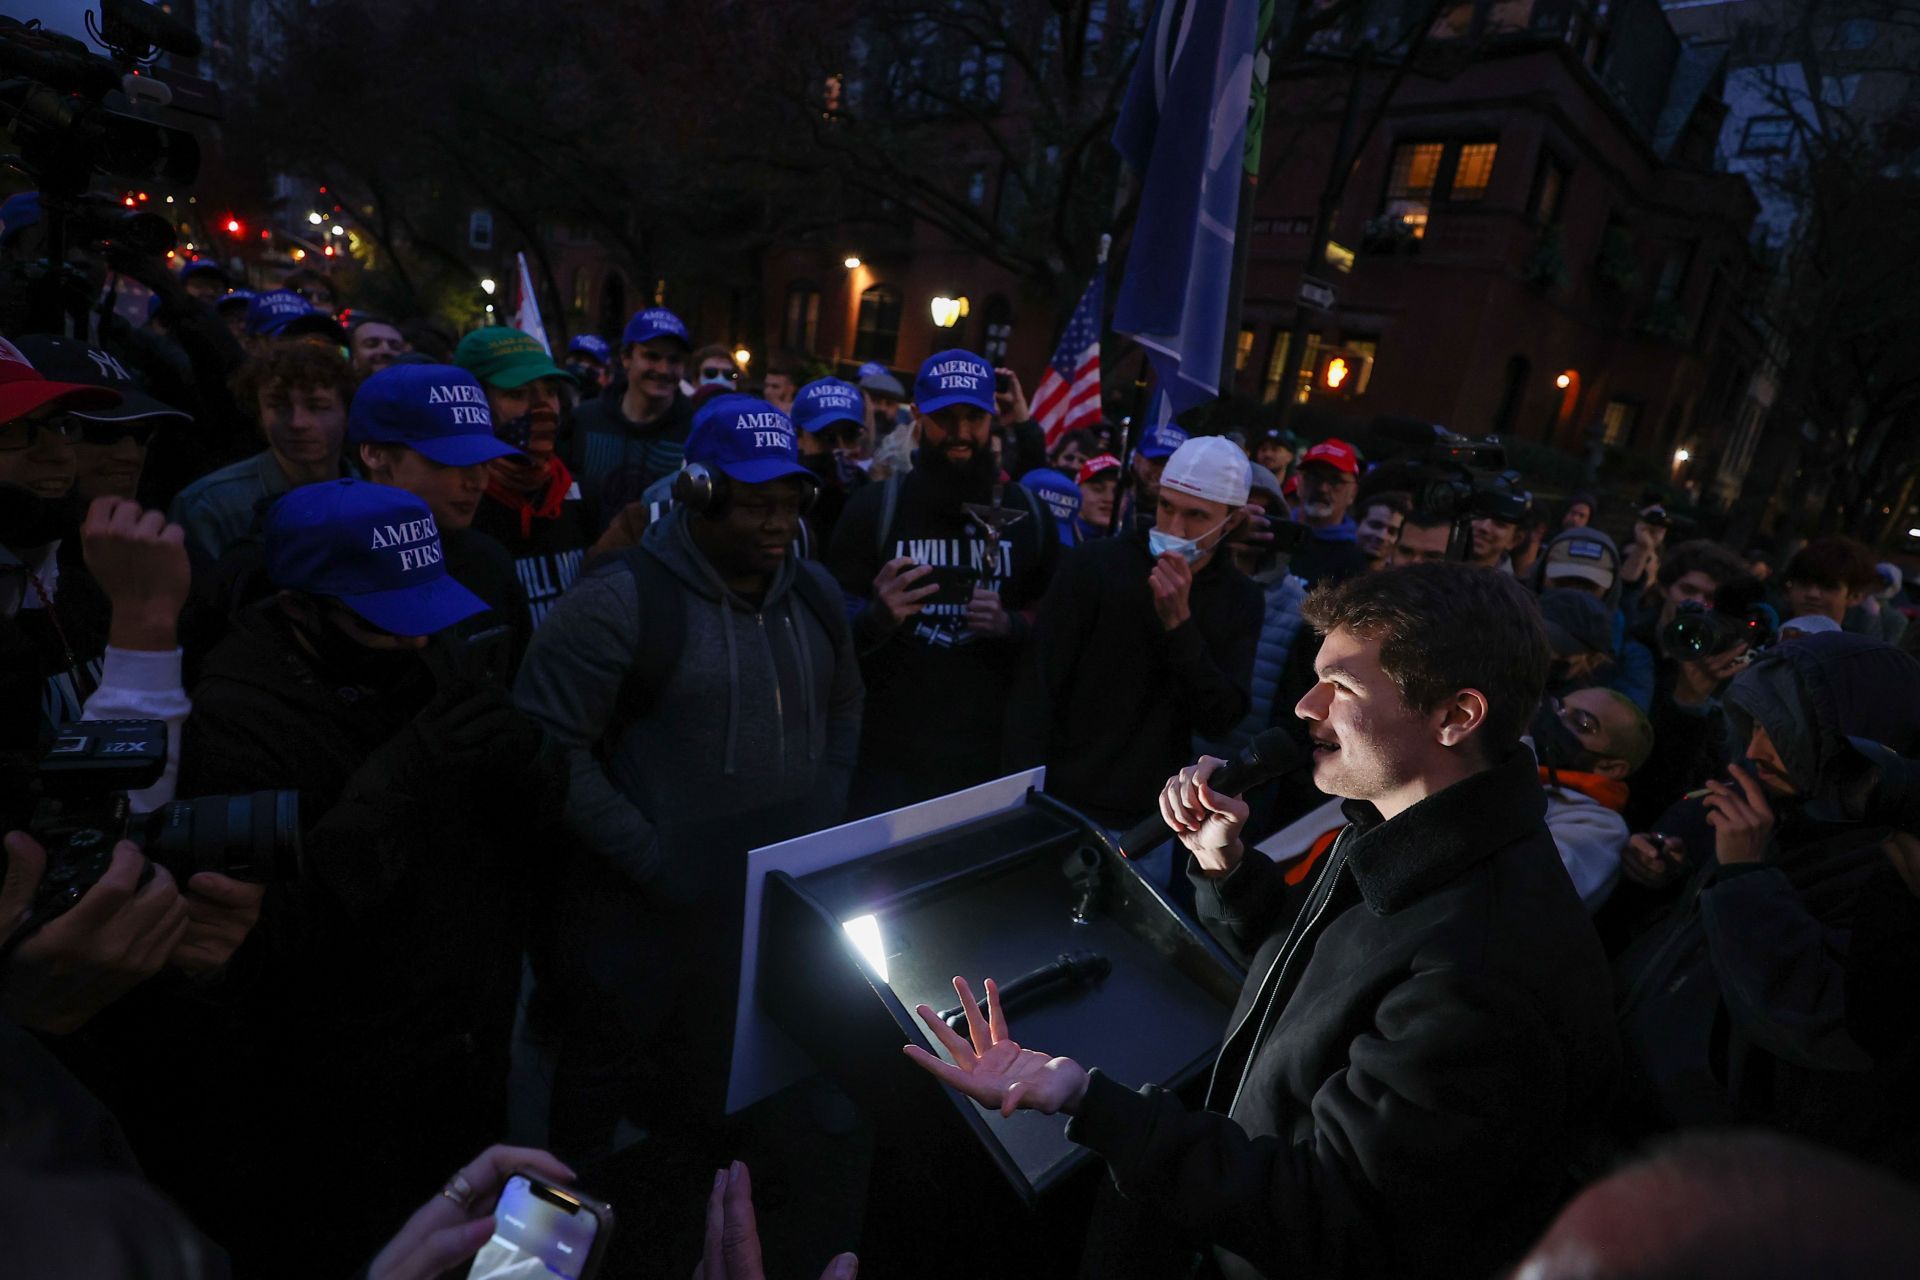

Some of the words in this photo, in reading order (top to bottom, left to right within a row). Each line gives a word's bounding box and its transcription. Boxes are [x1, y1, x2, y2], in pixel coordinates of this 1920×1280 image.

[928, 360, 989, 378] AMERICA
[940, 375, 979, 390] FIRST
[819, 396, 851, 409] FIRST
[554, 547, 584, 592] NO
